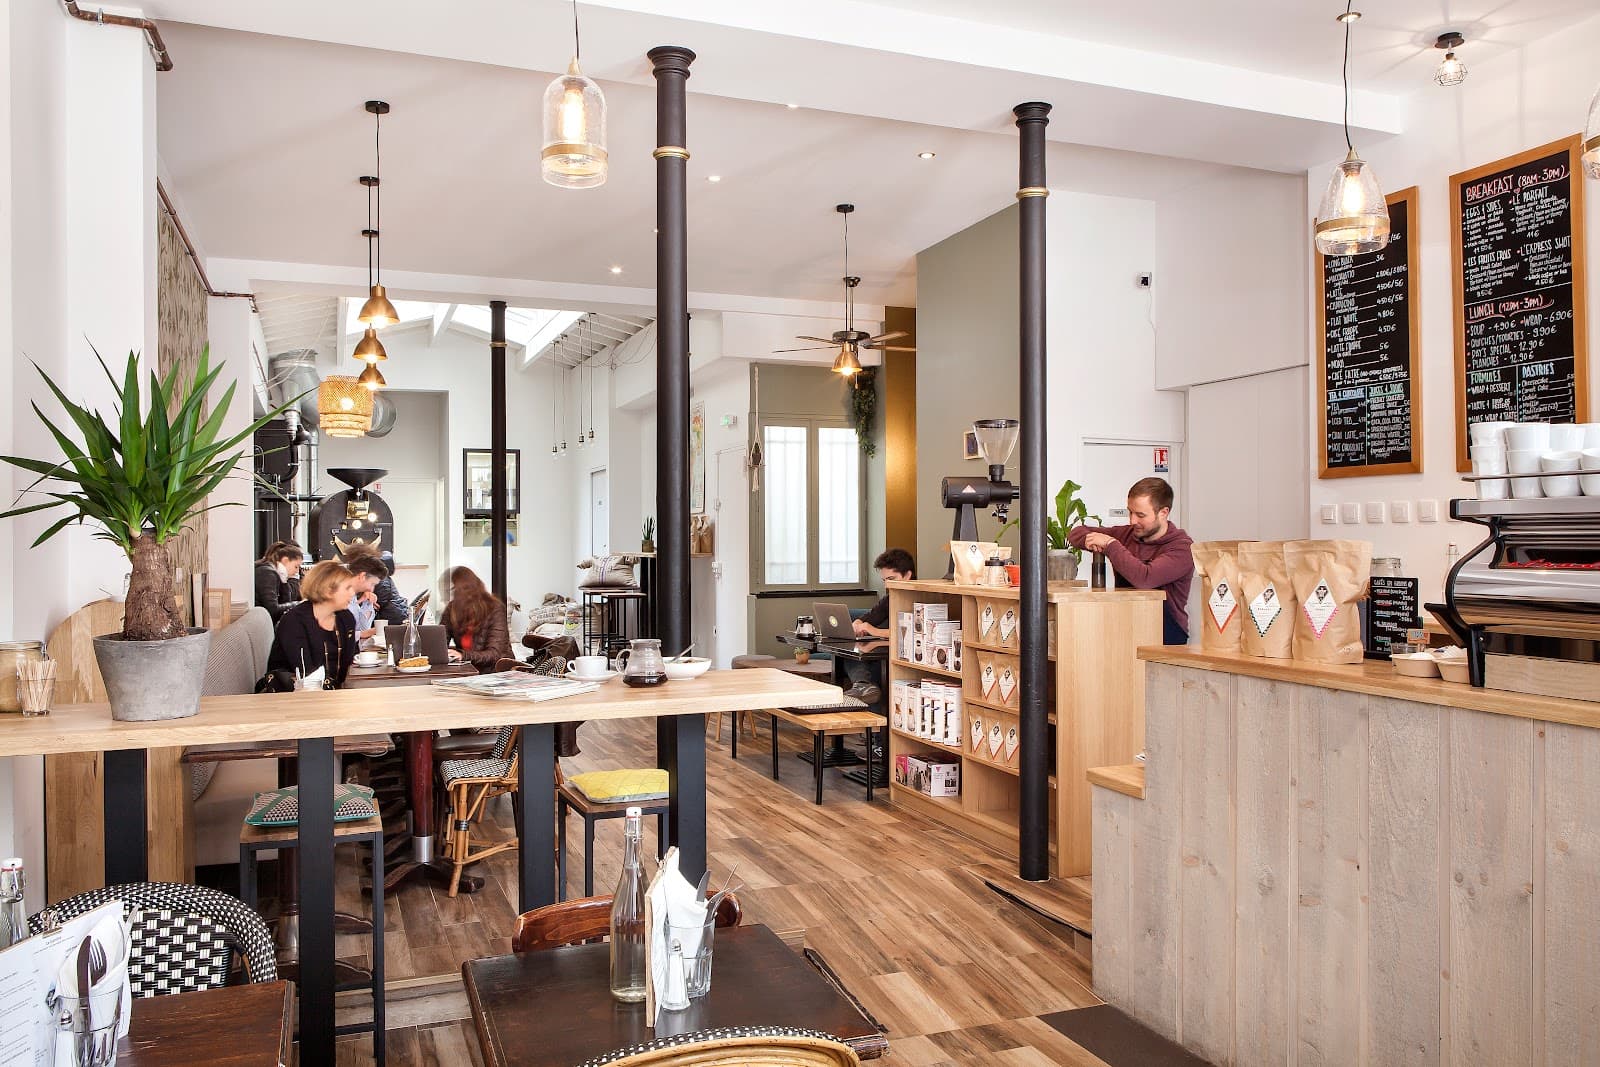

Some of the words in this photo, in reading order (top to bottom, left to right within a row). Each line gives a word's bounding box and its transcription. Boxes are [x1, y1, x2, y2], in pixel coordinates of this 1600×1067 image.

[1466, 174, 1513, 201] BREAKFAST
[1513, 193, 1520, 205] LE
[1466, 206, 1480, 219] EGGS
[1486, 200, 1501, 212] SIDES
[1468, 256, 1476, 267] LES
[1469, 303, 1494, 319] LUNCH
[1331, 316, 1341, 326] FLAT
[1523, 314, 1543, 326] WRAP
[1470, 323, 1485, 336] SOUP
[1490, 344, 1511, 356] SPECIAL
[1522, 362, 1554, 378] PASTRIES
[1471, 370, 1501, 385] FORMULES
[1490, 382, 1511, 393] DESSERT
[1331, 402, 1340, 411] TEA
